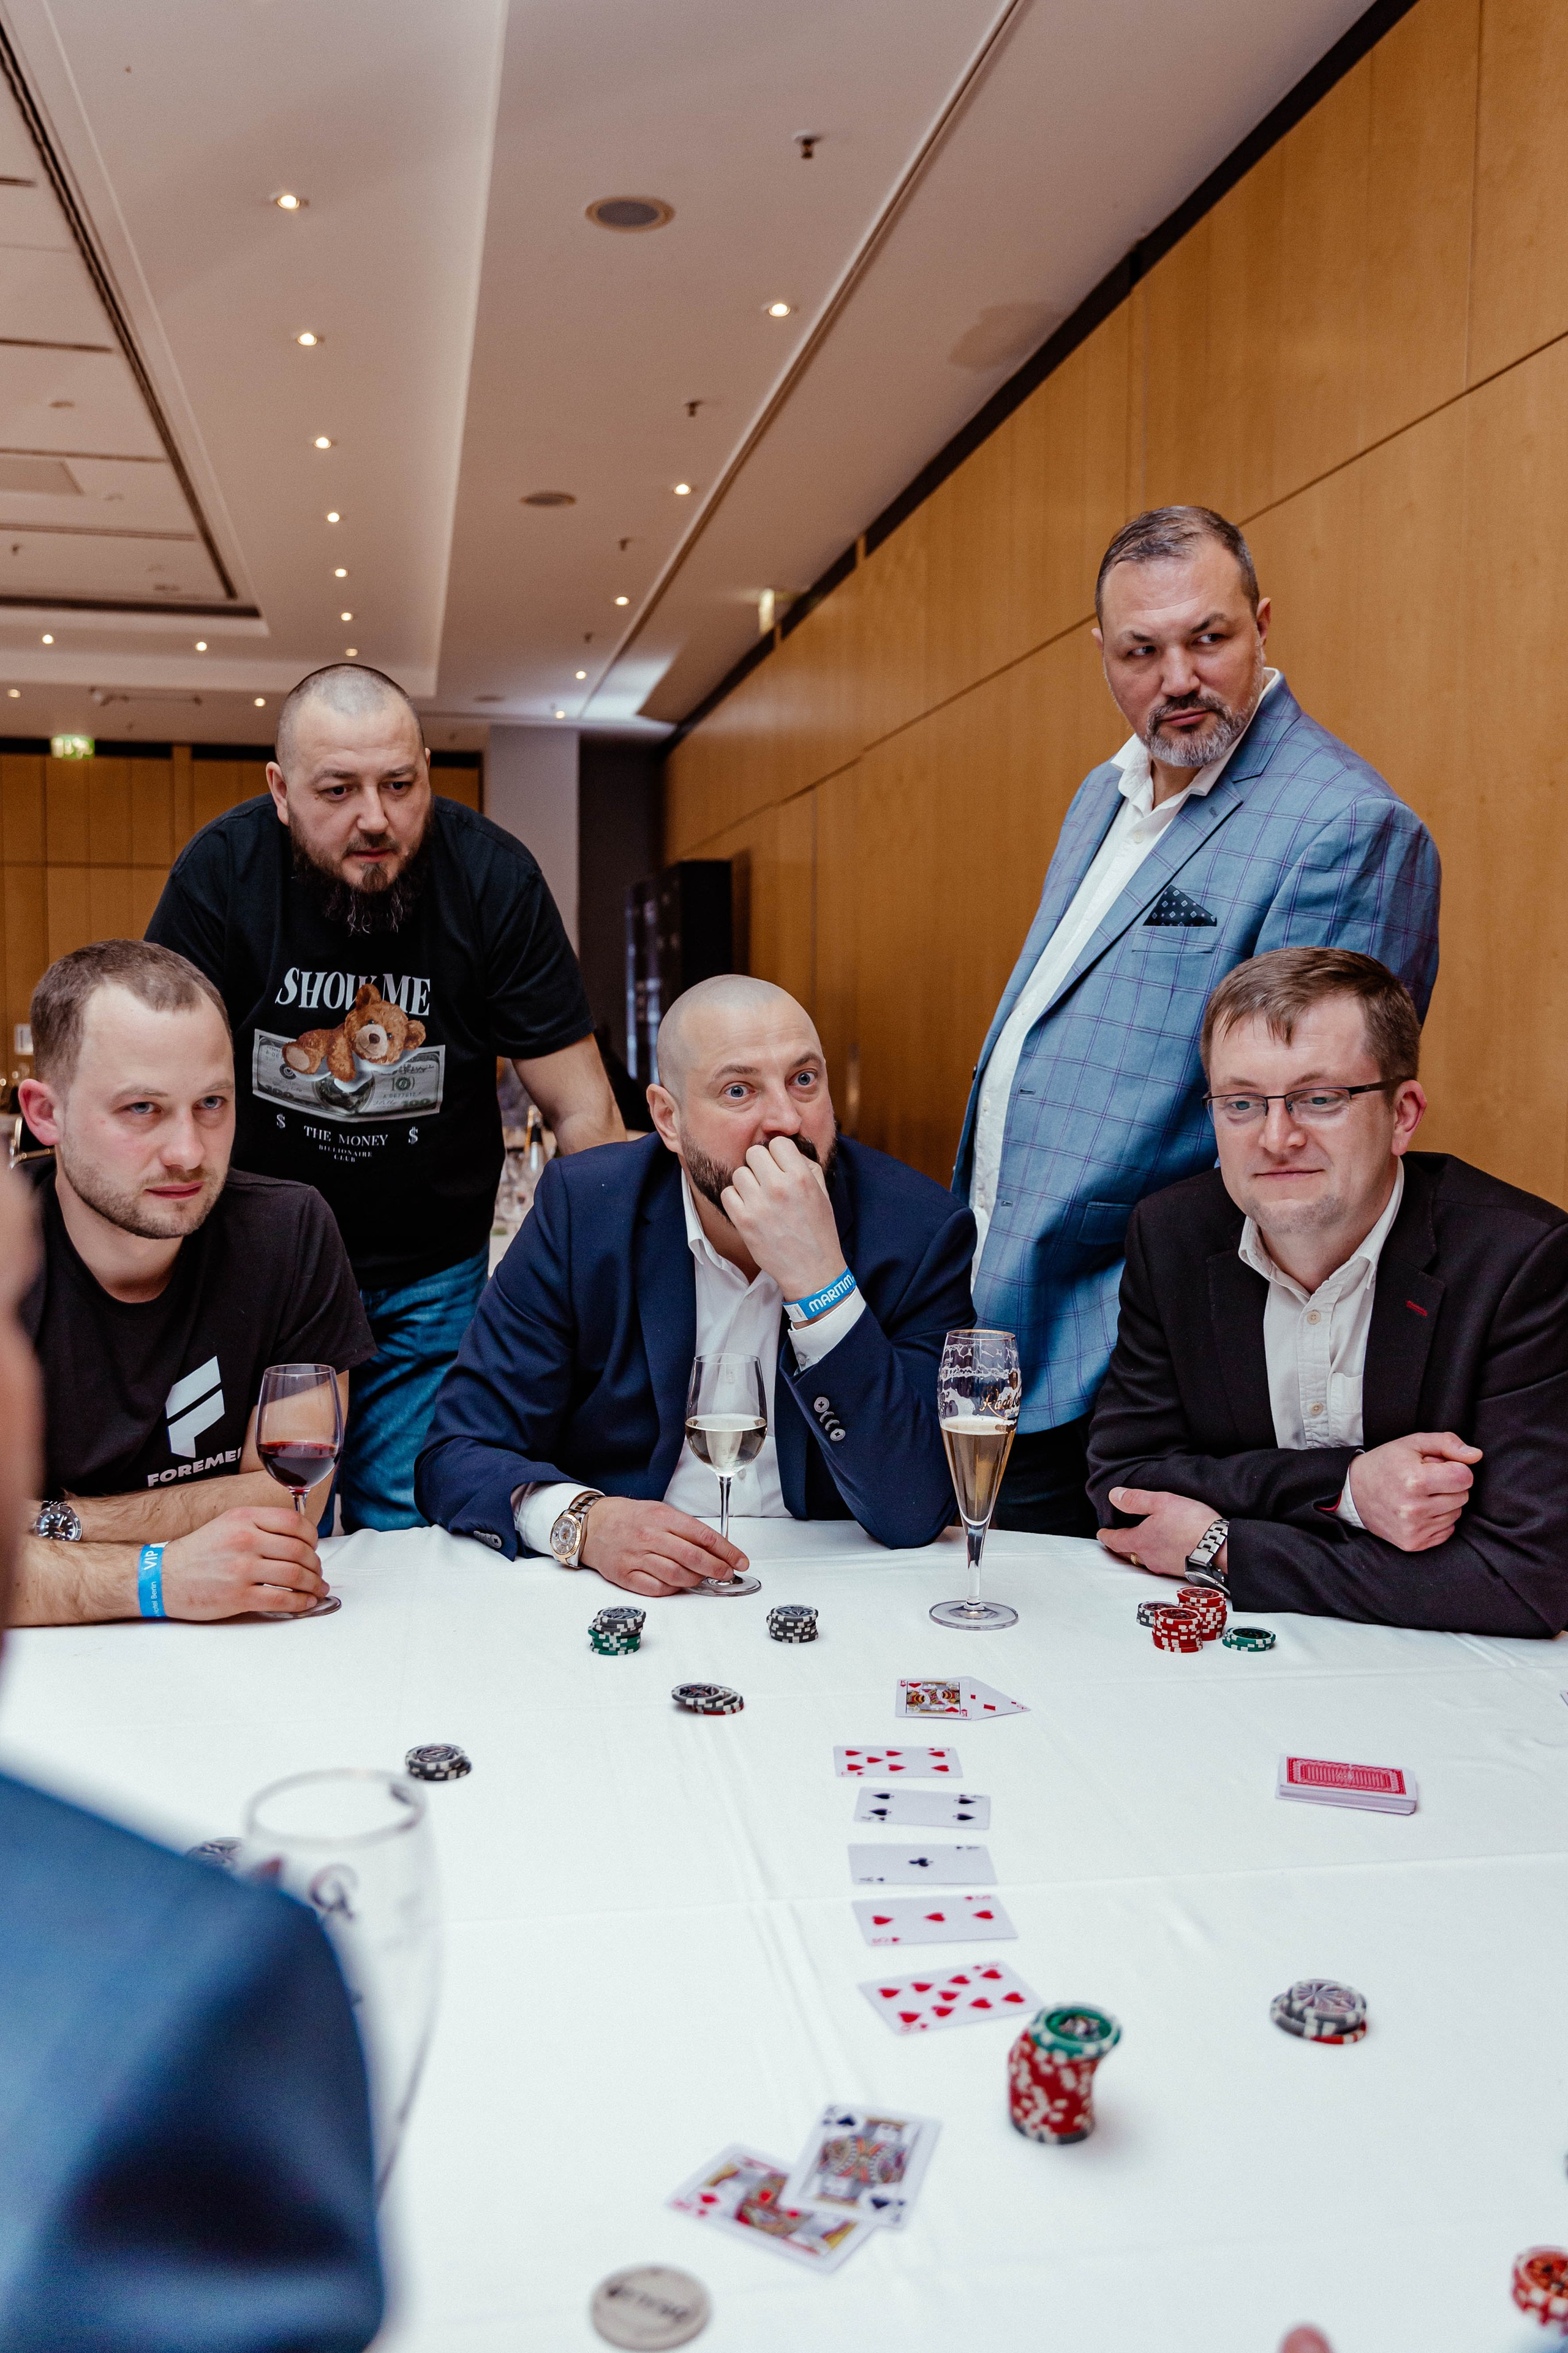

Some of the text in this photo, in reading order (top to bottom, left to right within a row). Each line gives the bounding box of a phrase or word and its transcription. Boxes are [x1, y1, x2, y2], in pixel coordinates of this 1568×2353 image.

[275, 967, 430, 1016] SHOW ME
[304, 1125, 331, 1142] THE
[339, 1134, 388, 1147] MONEY
[318, 1144, 372, 1158] BILLIONAIRE
[334, 1154, 356, 1163] CLUB
[809, 1274, 854, 1312] MARITIM
[144, 1550, 159, 1570] VIP
